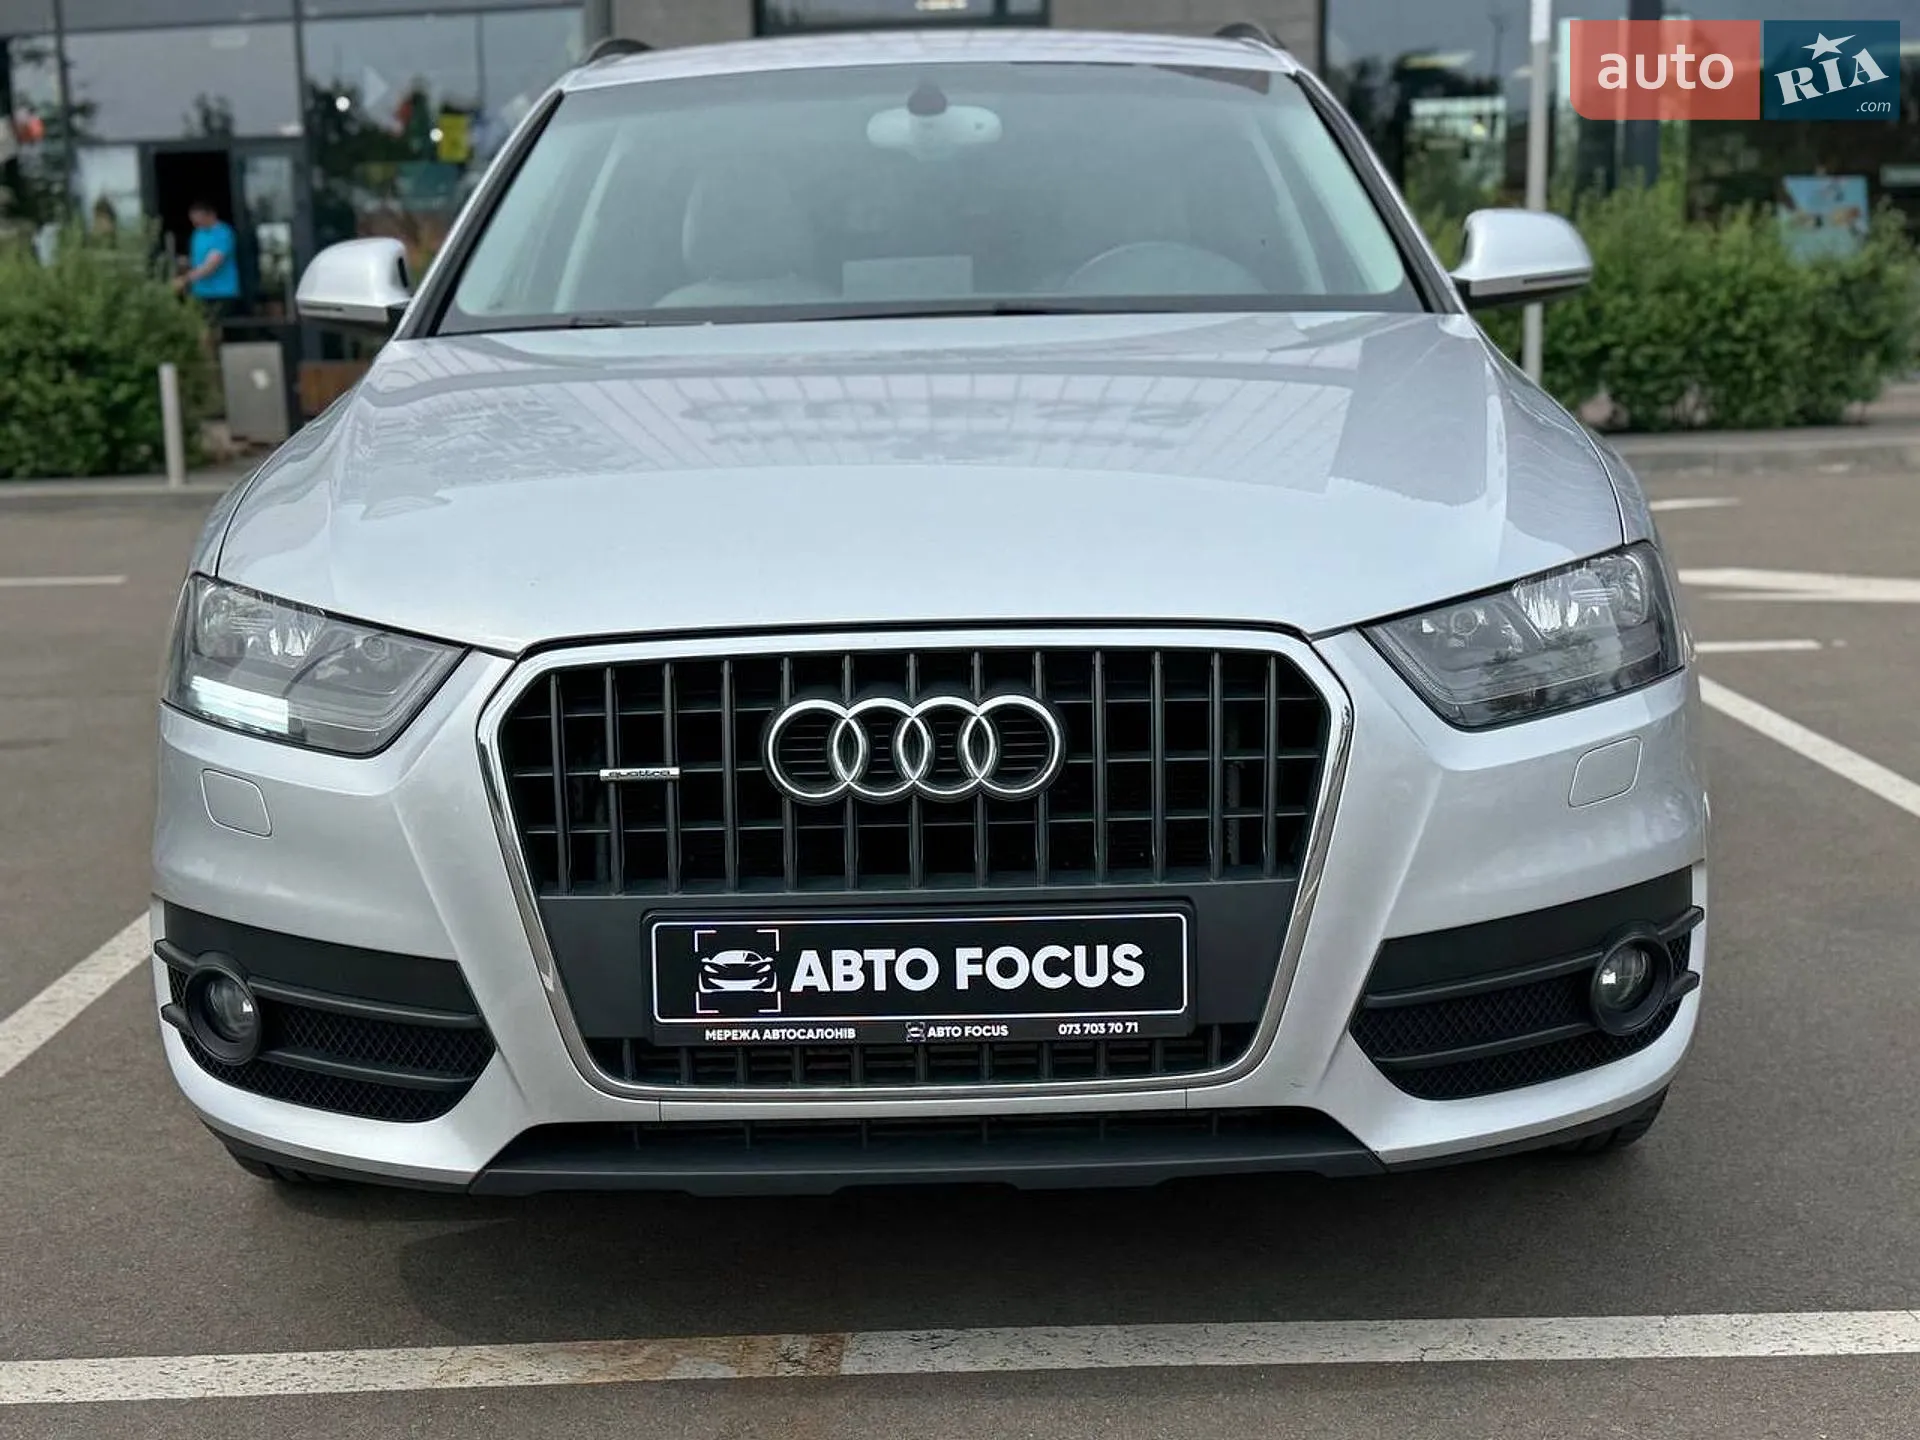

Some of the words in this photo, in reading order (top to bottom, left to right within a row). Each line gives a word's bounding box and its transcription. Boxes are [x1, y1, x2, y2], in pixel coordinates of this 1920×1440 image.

[790, 947, 940, 993] АВТО
[956, 942, 1146, 991] FOCUS
[704, 1028, 761, 1041] МЕРЕЖА
[762, 1027, 857, 1041] АВТОСАЛОНІВ
[927, 1025, 963, 1038] АВТО
[964, 1024, 1009, 1038] FOCUS
[1058, 1023, 1081, 1035] 073
[1083, 1023, 1106, 1035] 703
[1108, 1022, 1124, 1034] 70
[1125, 1021, 1139, 1034] 71
